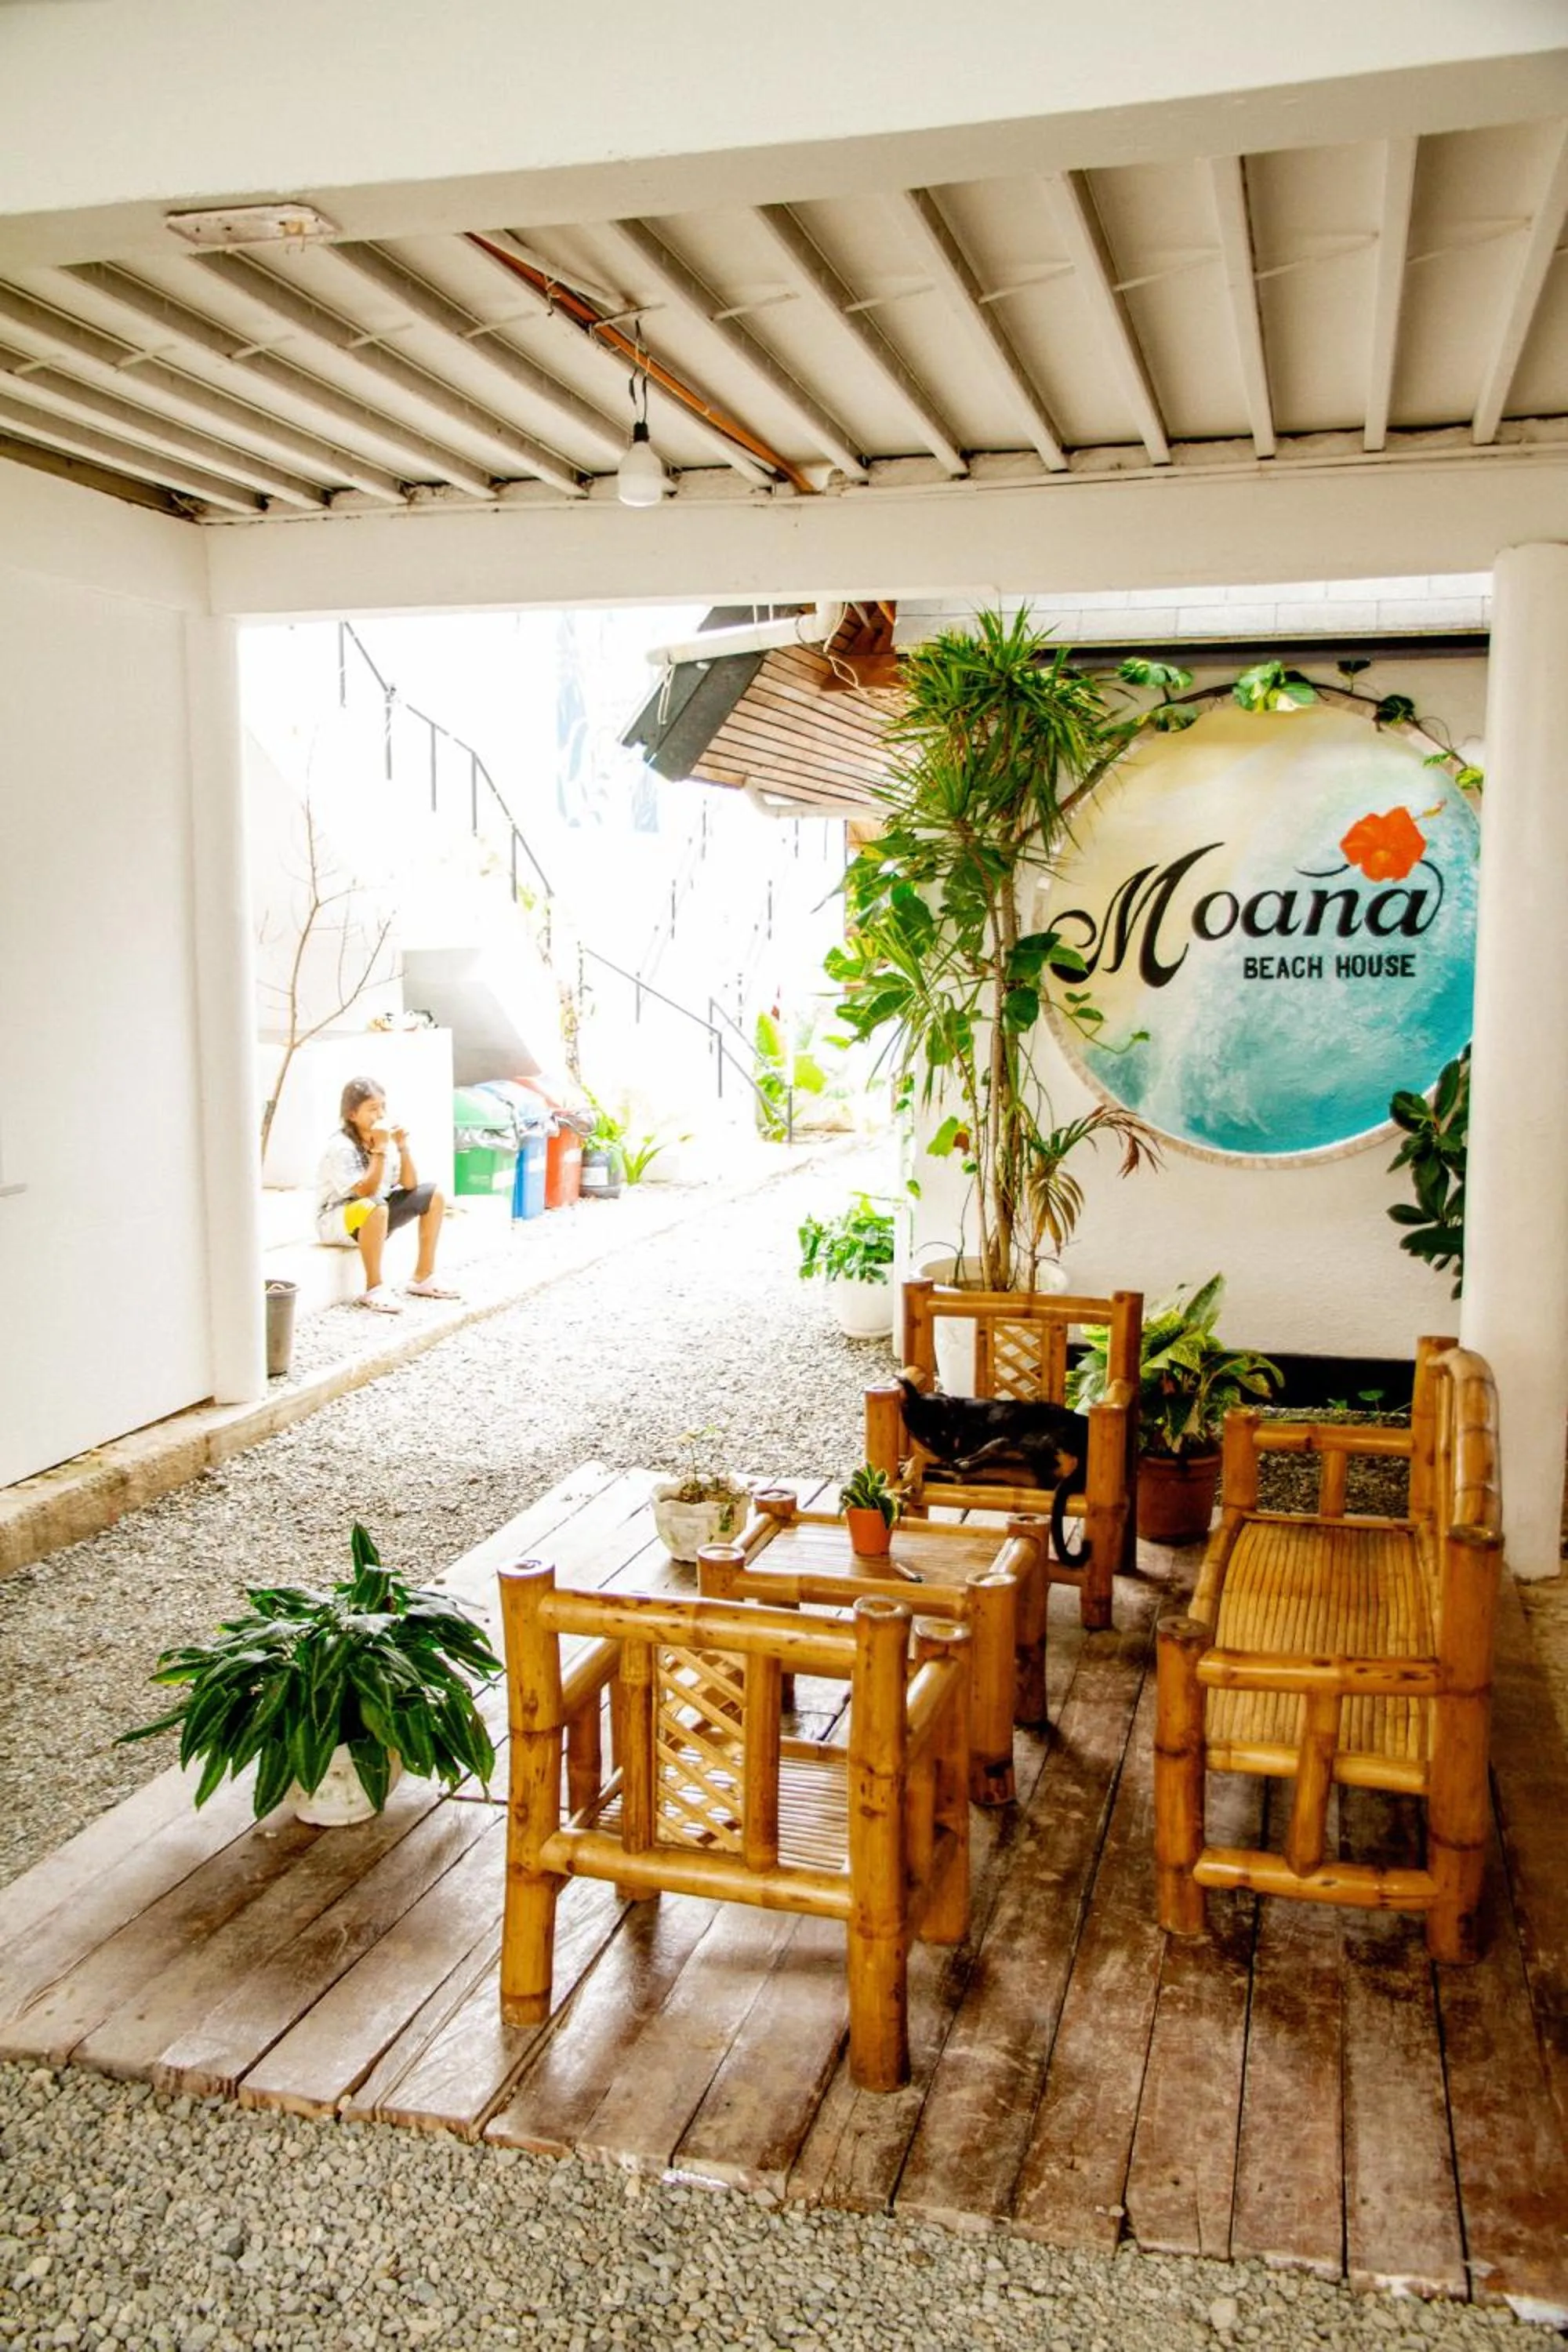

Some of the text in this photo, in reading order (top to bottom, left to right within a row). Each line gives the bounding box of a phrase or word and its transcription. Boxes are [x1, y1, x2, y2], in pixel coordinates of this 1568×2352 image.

[1047, 841, 1443, 988] Moana
[1244, 954, 1416, 979] BEACH HOUSE
